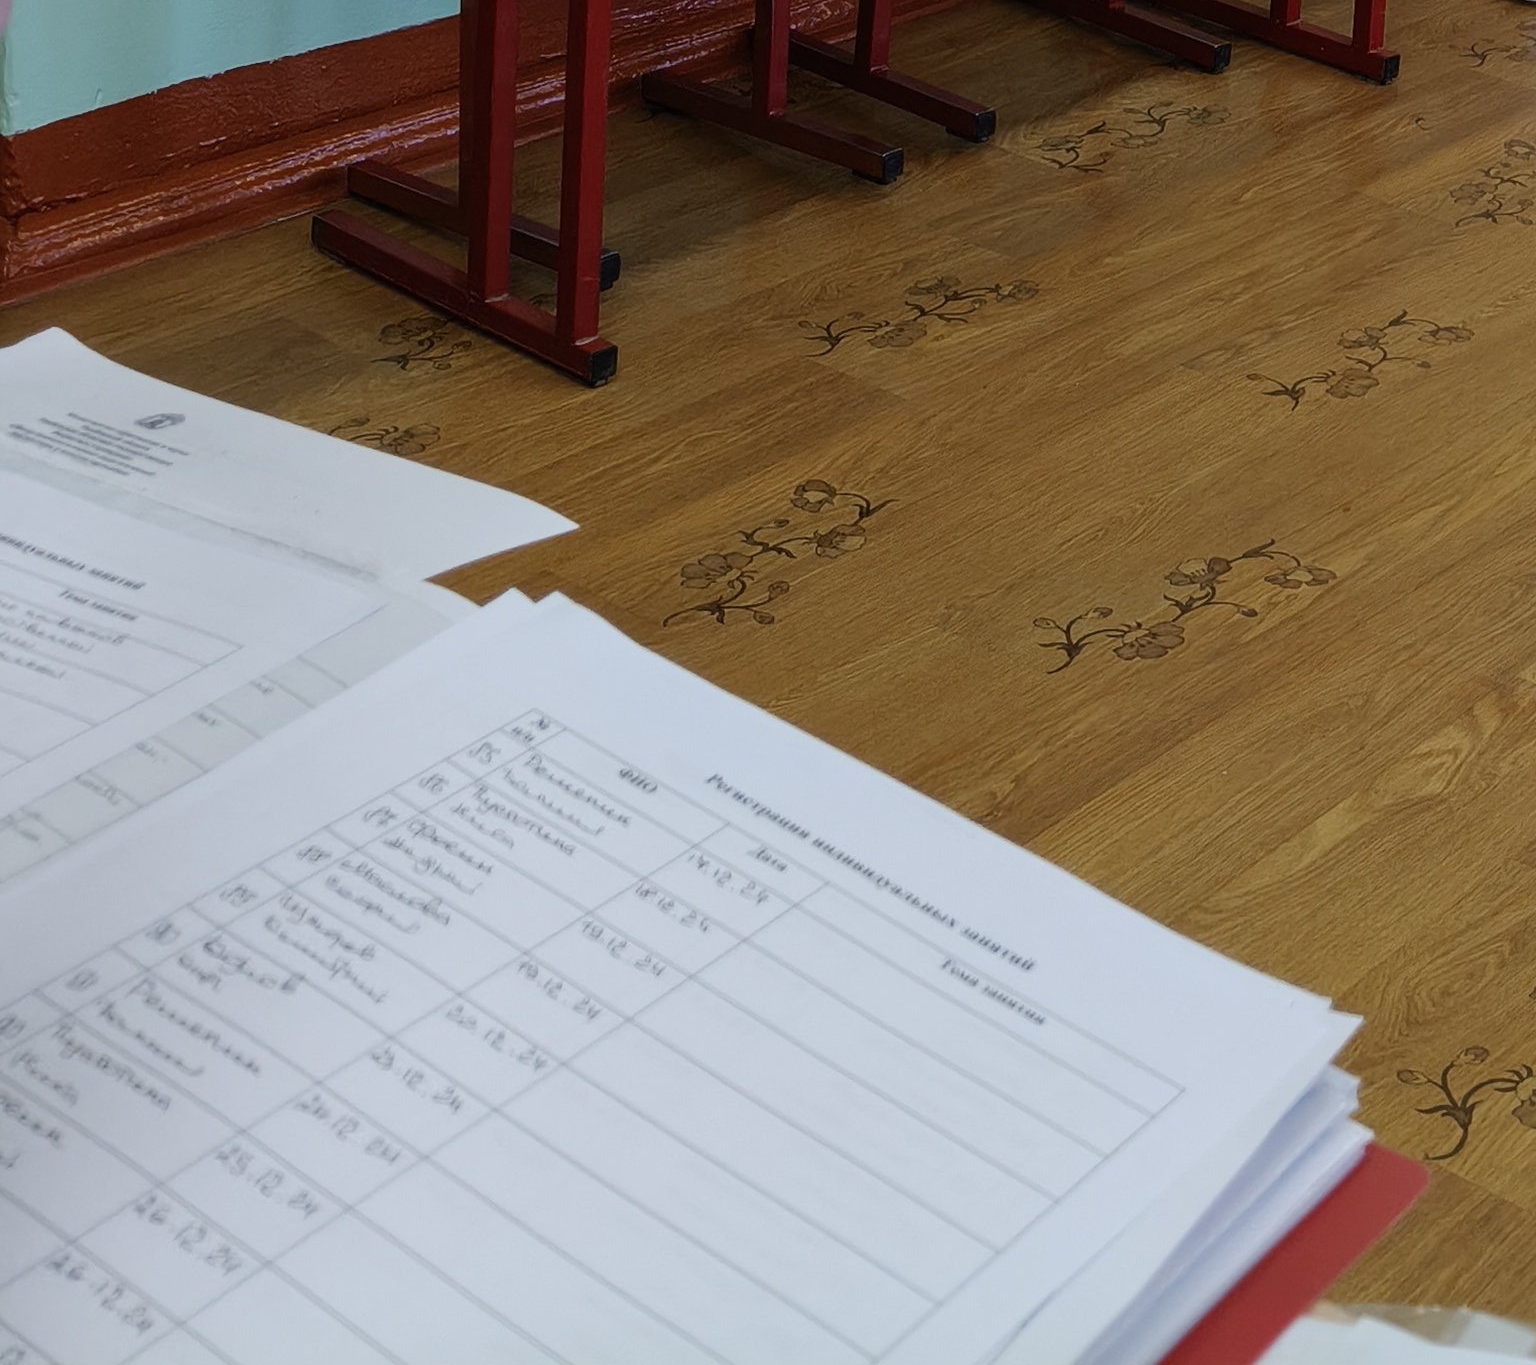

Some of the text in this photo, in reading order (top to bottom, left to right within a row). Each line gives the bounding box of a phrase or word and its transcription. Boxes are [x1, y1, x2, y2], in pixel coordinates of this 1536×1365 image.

[619, 768, 658, 793] ФИО
[705, 773, 811, 840] Регистрация
[812, 837, 959, 931] индивидуальных
[961, 927, 1036, 972] занятий
